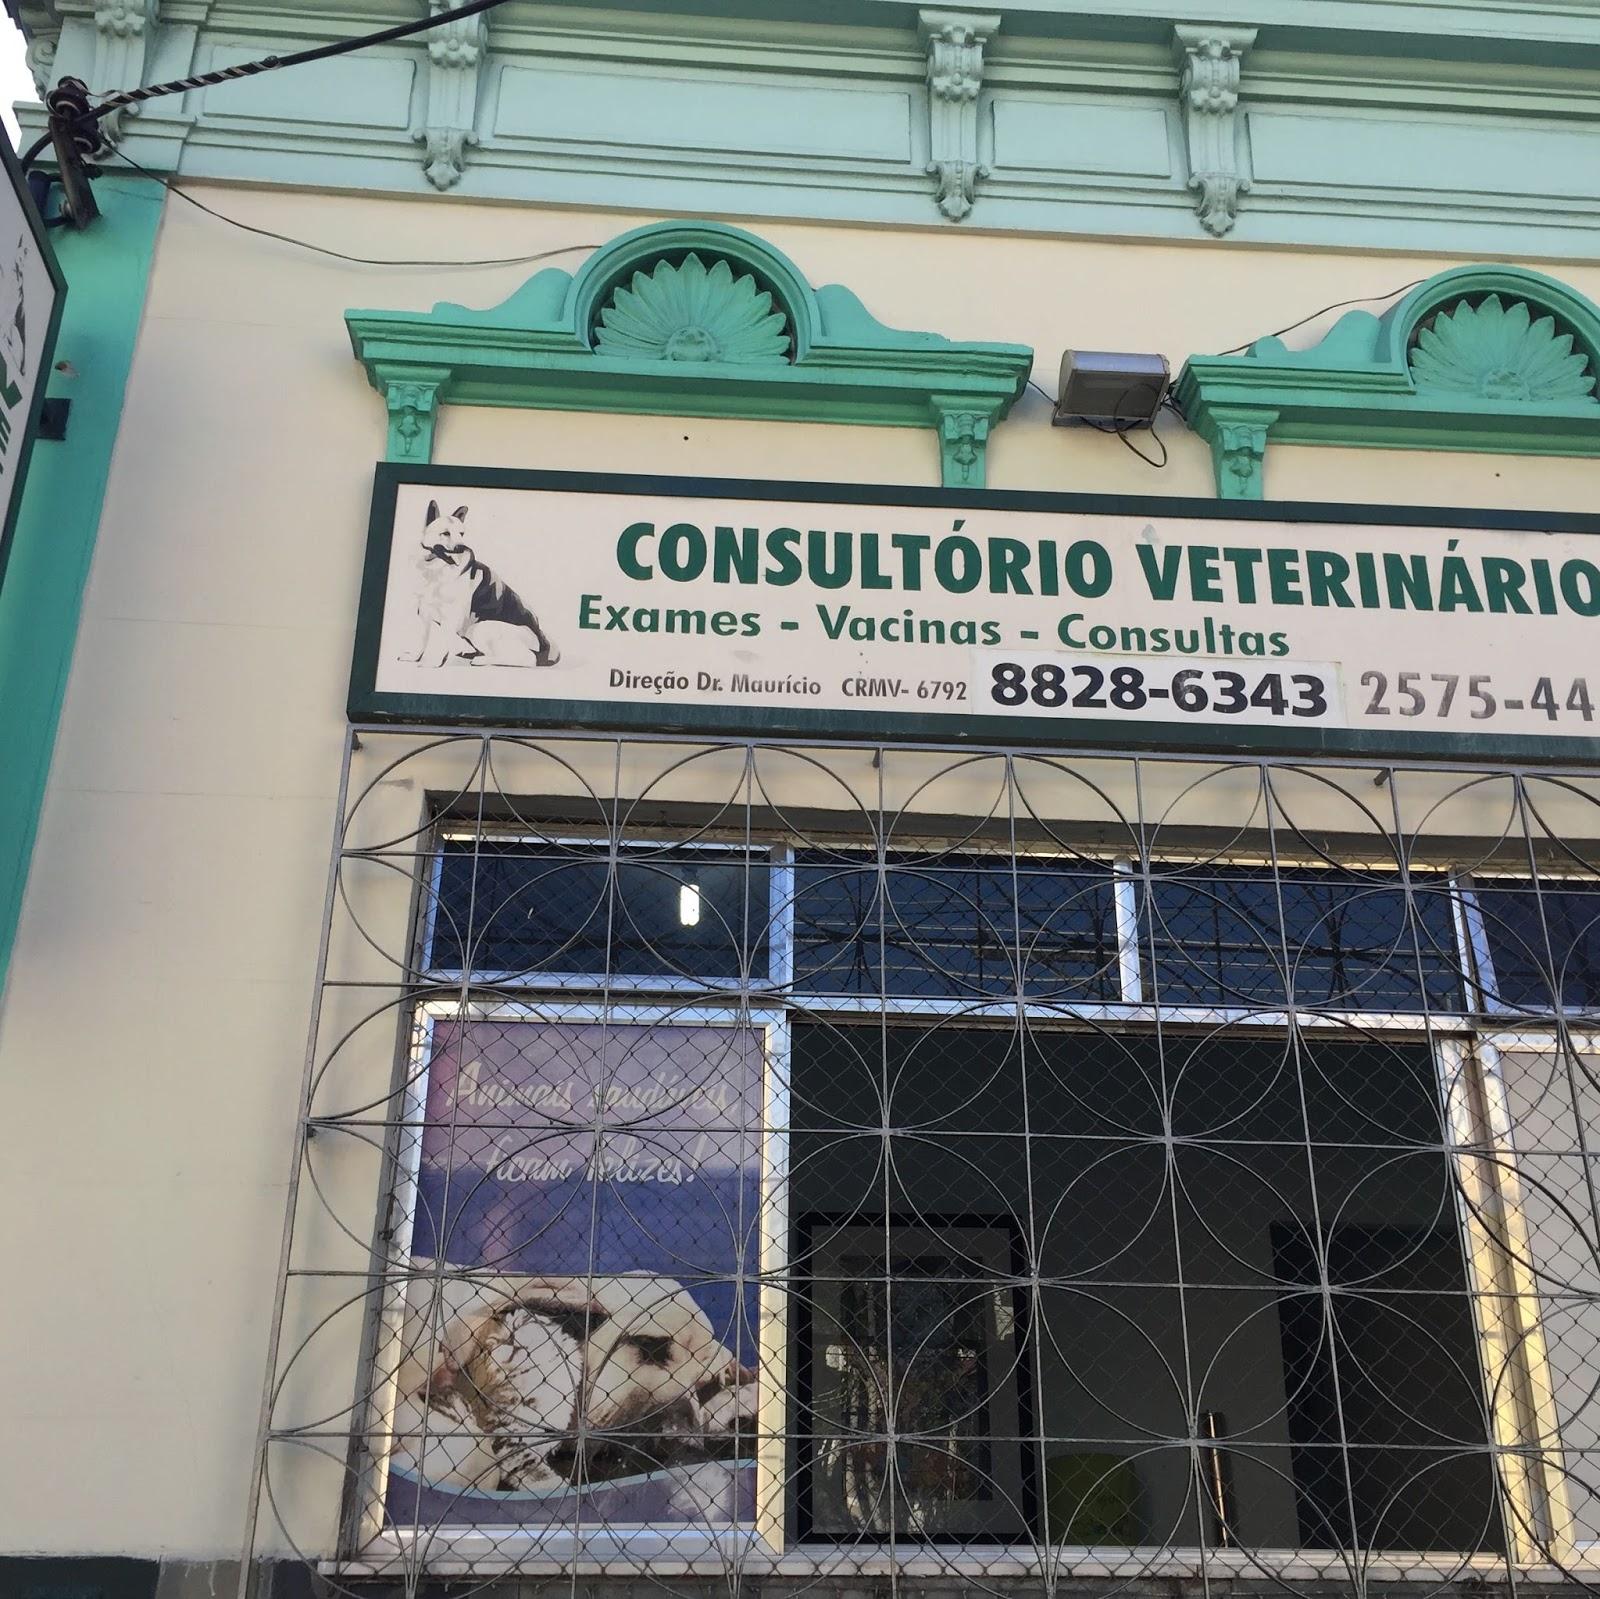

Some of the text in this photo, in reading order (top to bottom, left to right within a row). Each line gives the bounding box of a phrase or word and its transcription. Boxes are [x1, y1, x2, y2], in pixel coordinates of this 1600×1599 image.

[616, 520, 1600, 617] CONSULTÓRIO VETERINÁRIO
[578, 594, 1290, 656] Exames - Vacinas - Consultas
[609, 668, 967, 701] Direção Dr. Maurício CRMV- 6792
[990, 662, 1328, 717] 8828-6343
[1360, 670, 1596, 722] 2575-44
[446, 1060, 574, 1111] Animais
